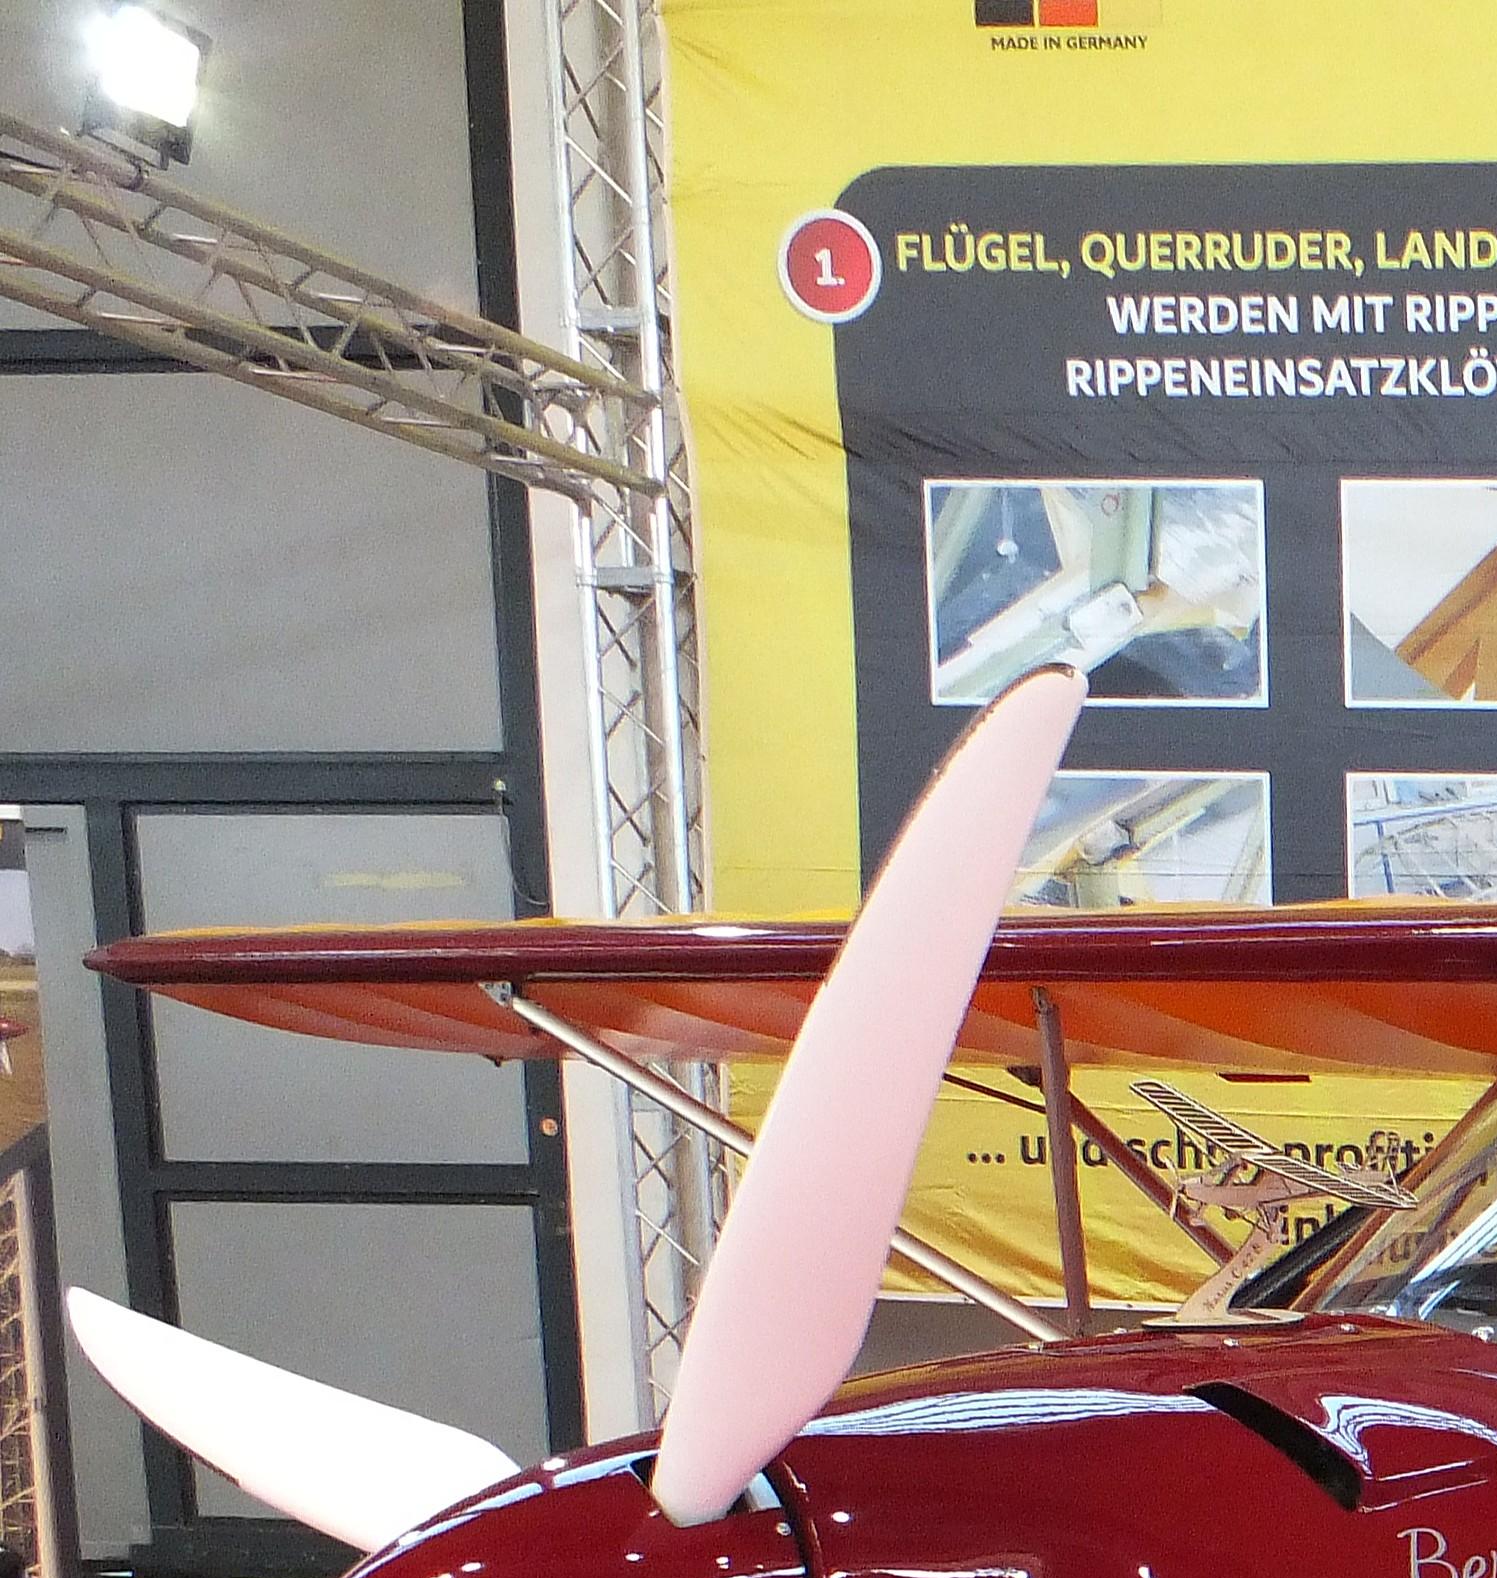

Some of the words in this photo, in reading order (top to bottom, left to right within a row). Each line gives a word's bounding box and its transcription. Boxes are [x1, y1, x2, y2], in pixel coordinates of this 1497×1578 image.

[991, 36, 1038, 50] MADE
[1043, 36, 1061, 50] IN
[1066, 35, 1148, 50] GERMANY
[896, 224, 1072, 279] FLÜGEL,
[1081, 230, 1367, 279] QUERRUDER,
[1106, 294, 1300, 336] WERDEN
[1312, 294, 1395, 336] MIT
